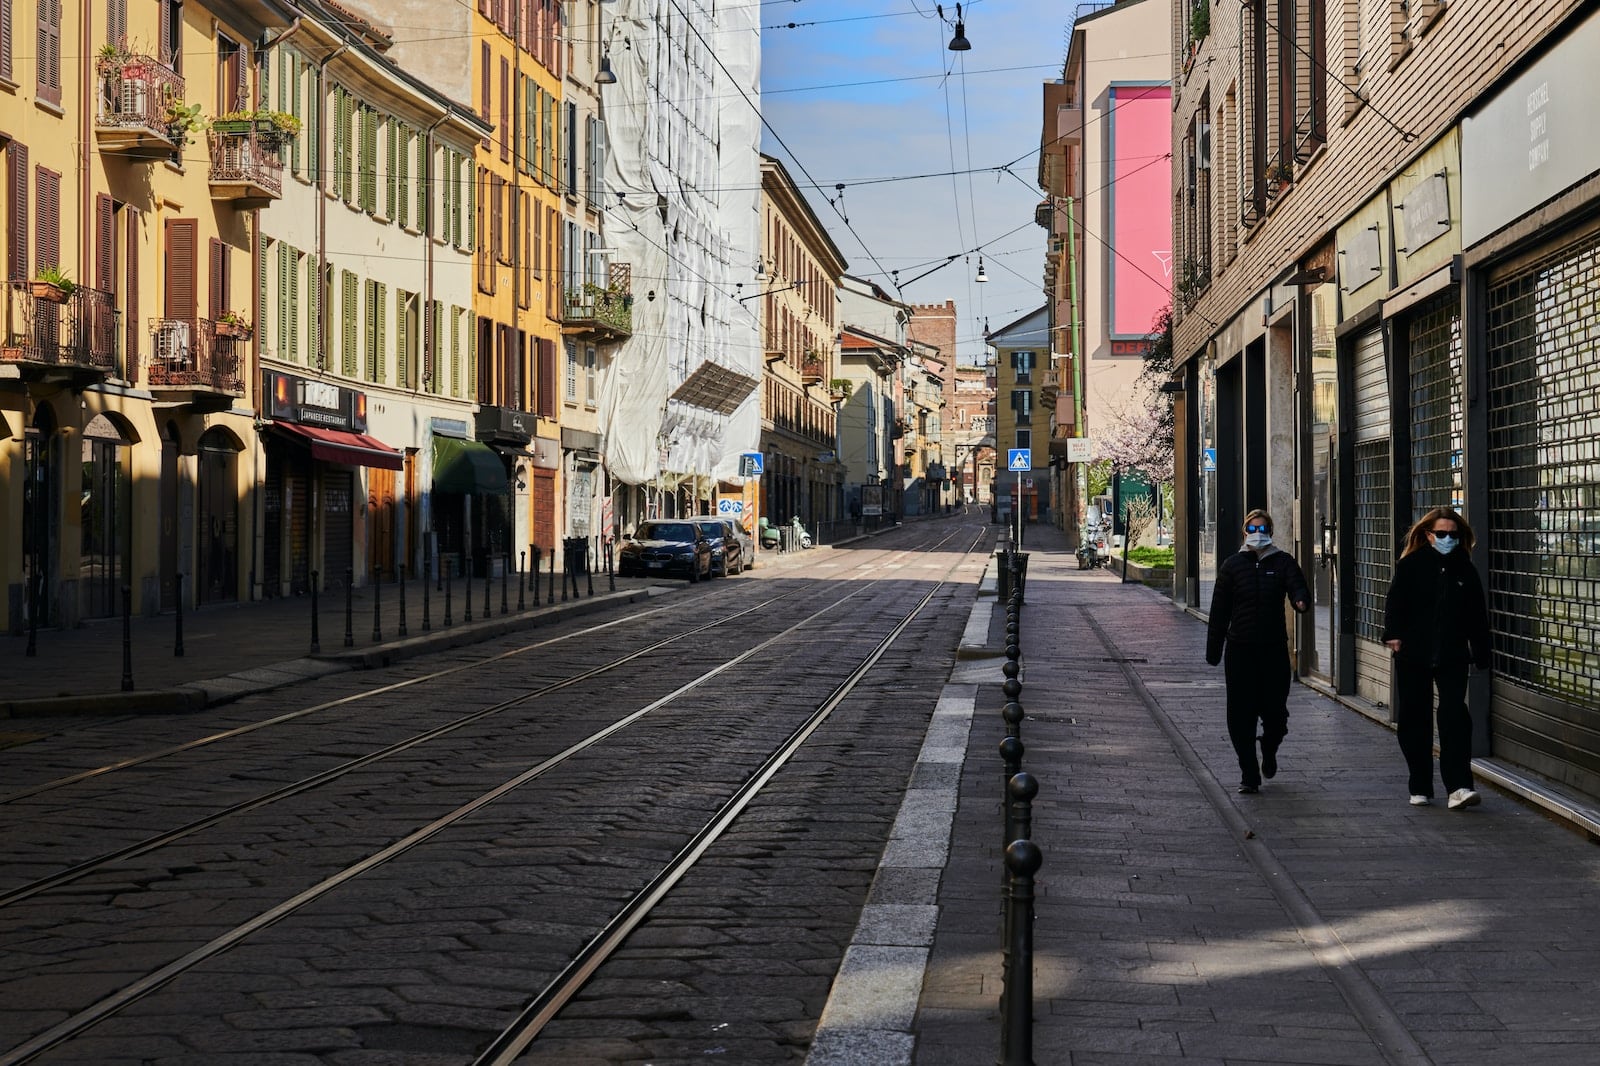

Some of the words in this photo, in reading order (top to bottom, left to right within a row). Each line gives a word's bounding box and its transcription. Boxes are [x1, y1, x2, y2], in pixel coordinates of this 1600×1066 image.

[1527, 80, 1549, 116] HERSCHEL
[1530, 112, 1546, 141] SUPPLY
[1528, 139, 1549, 171] COMPANY
[303, 411, 323, 421] JAPANESE
[323, 415, 346, 425] RESTAURANT
